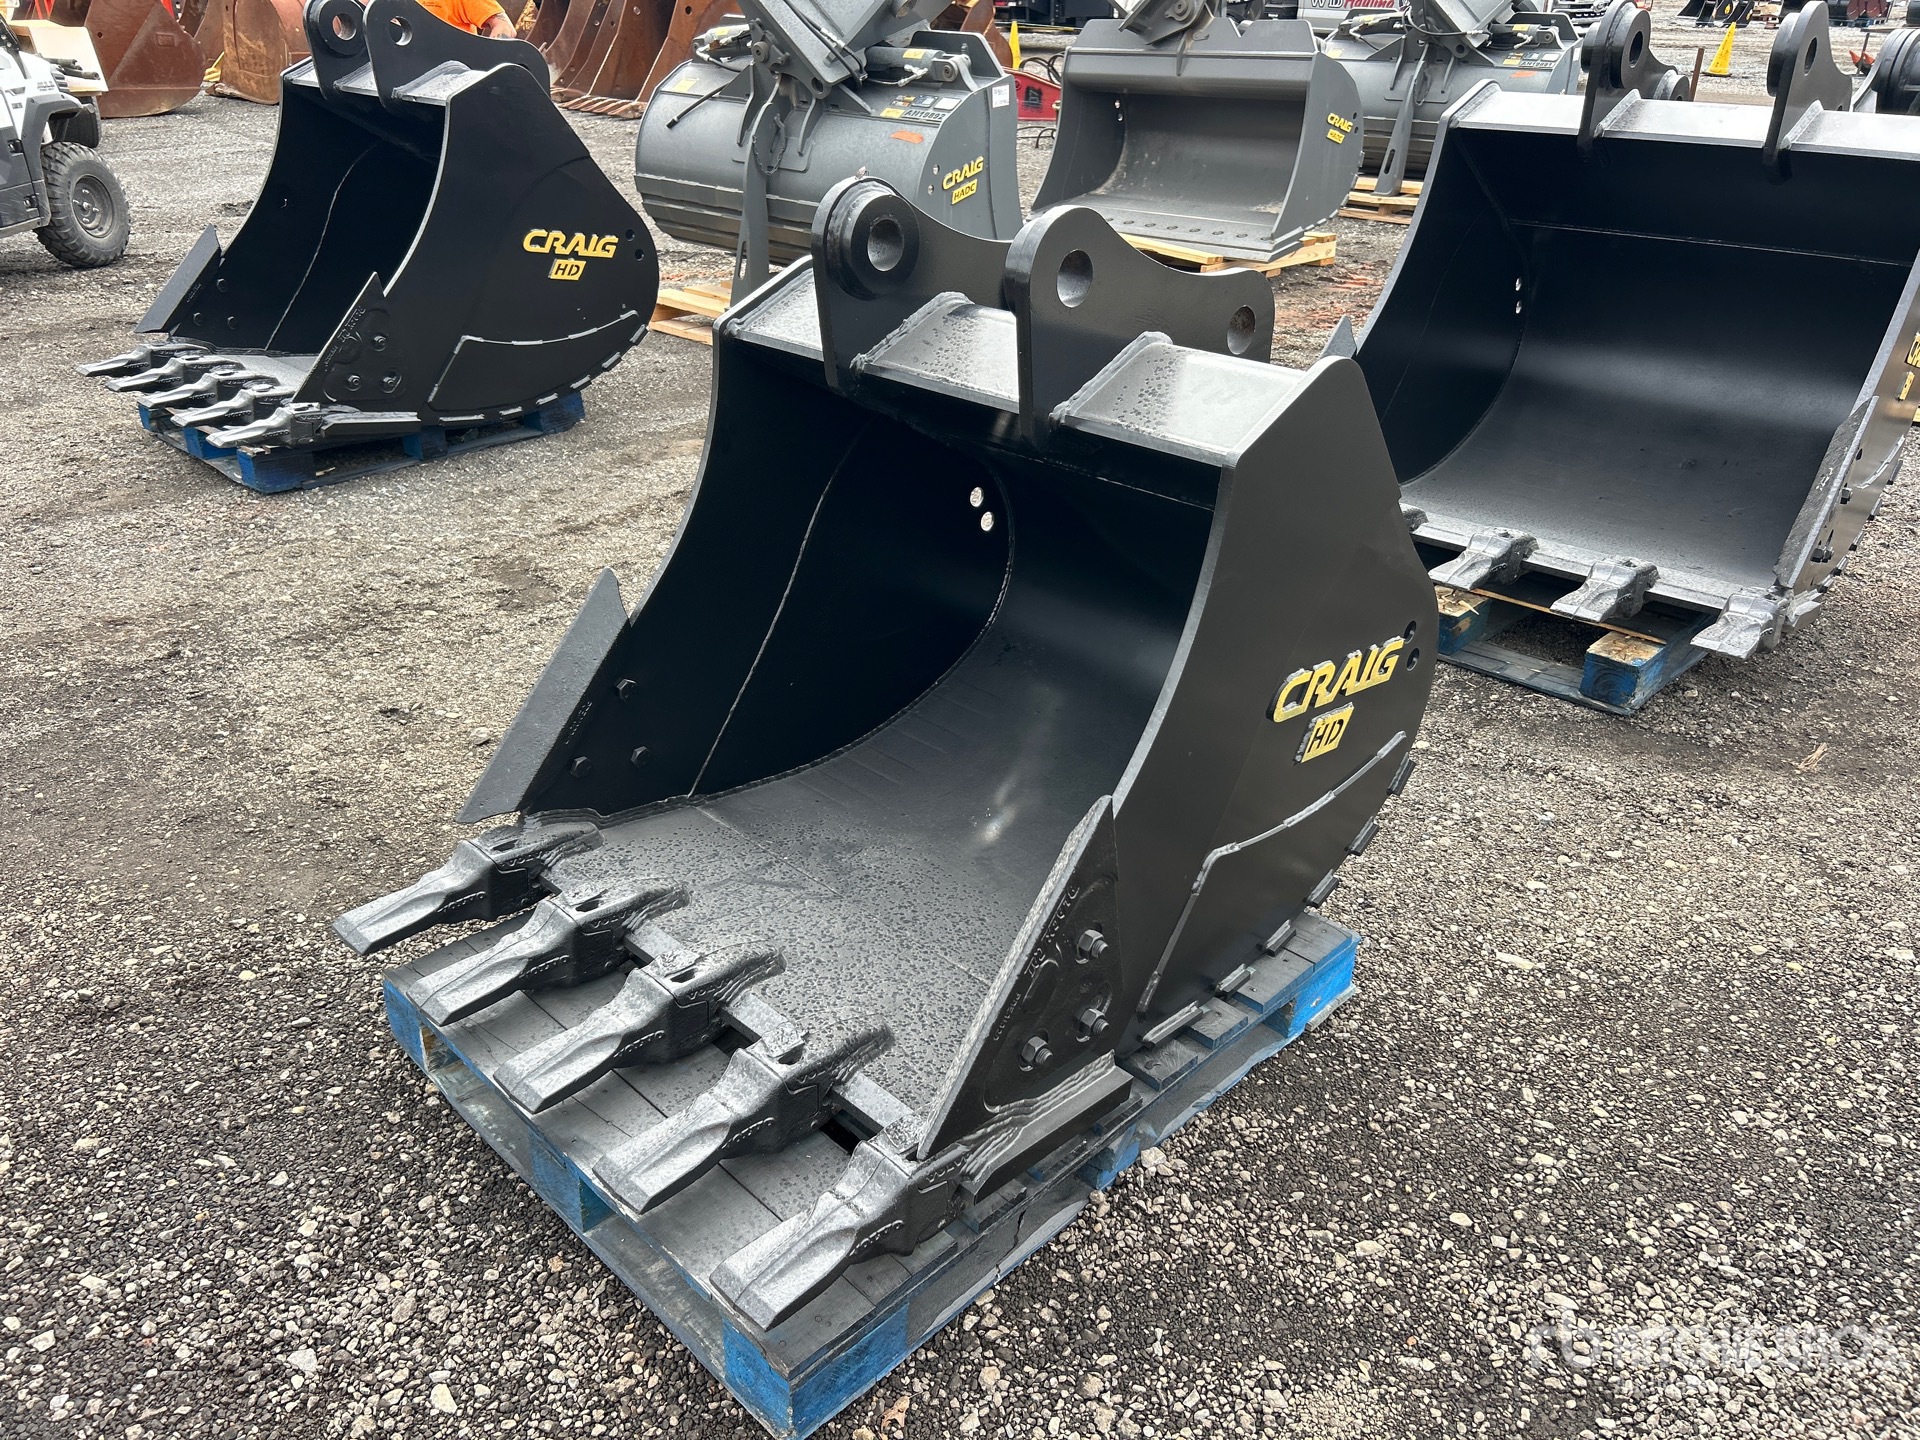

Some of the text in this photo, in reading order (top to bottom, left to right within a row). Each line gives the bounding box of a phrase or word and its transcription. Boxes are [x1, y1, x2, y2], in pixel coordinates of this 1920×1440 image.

[1326, 112, 1354, 133] CRAIG
[942, 156, 984, 190] CRAIG
[953, 183, 976, 201] HADC
[522, 229, 619, 259] CRAIG
[554, 263, 581, 277] HD
[1270, 635, 1405, 723] CRAIG
[1307, 718, 1345, 754] HD
